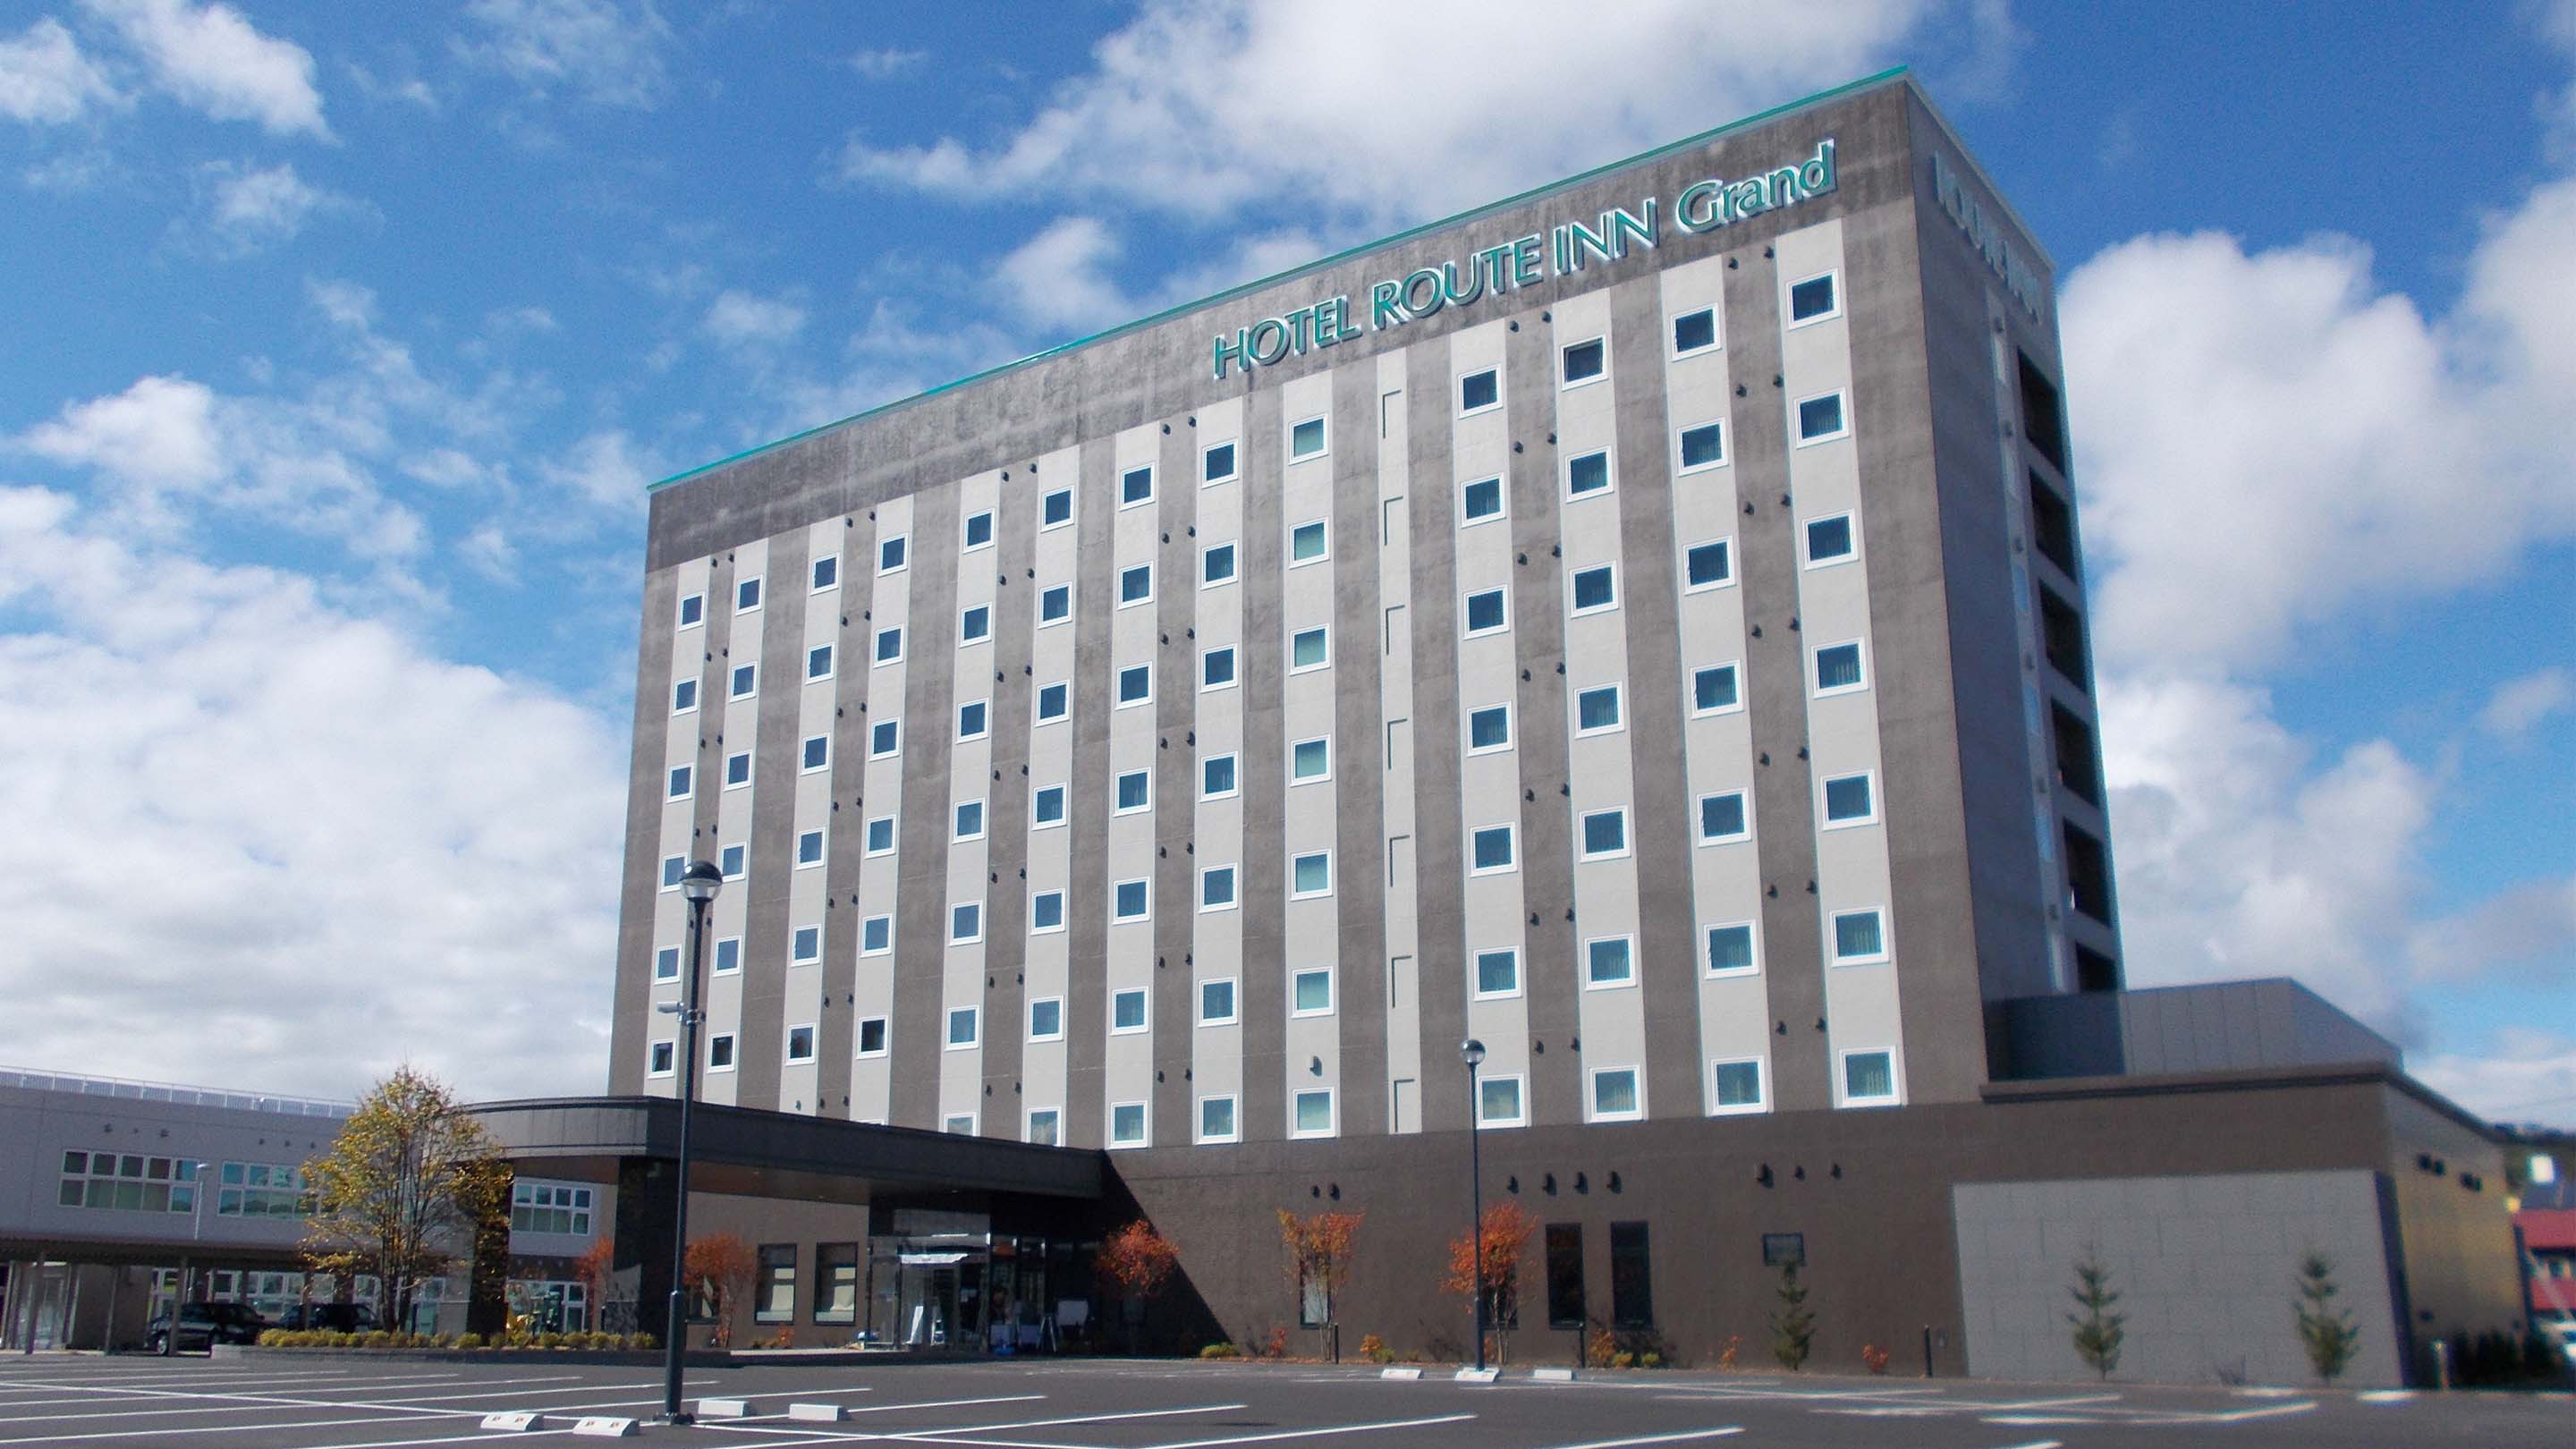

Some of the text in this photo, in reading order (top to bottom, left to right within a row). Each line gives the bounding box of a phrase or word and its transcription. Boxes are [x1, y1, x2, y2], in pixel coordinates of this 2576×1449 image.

[1214, 139, 1838, 380] HOTEL ROUTE INN Grand
